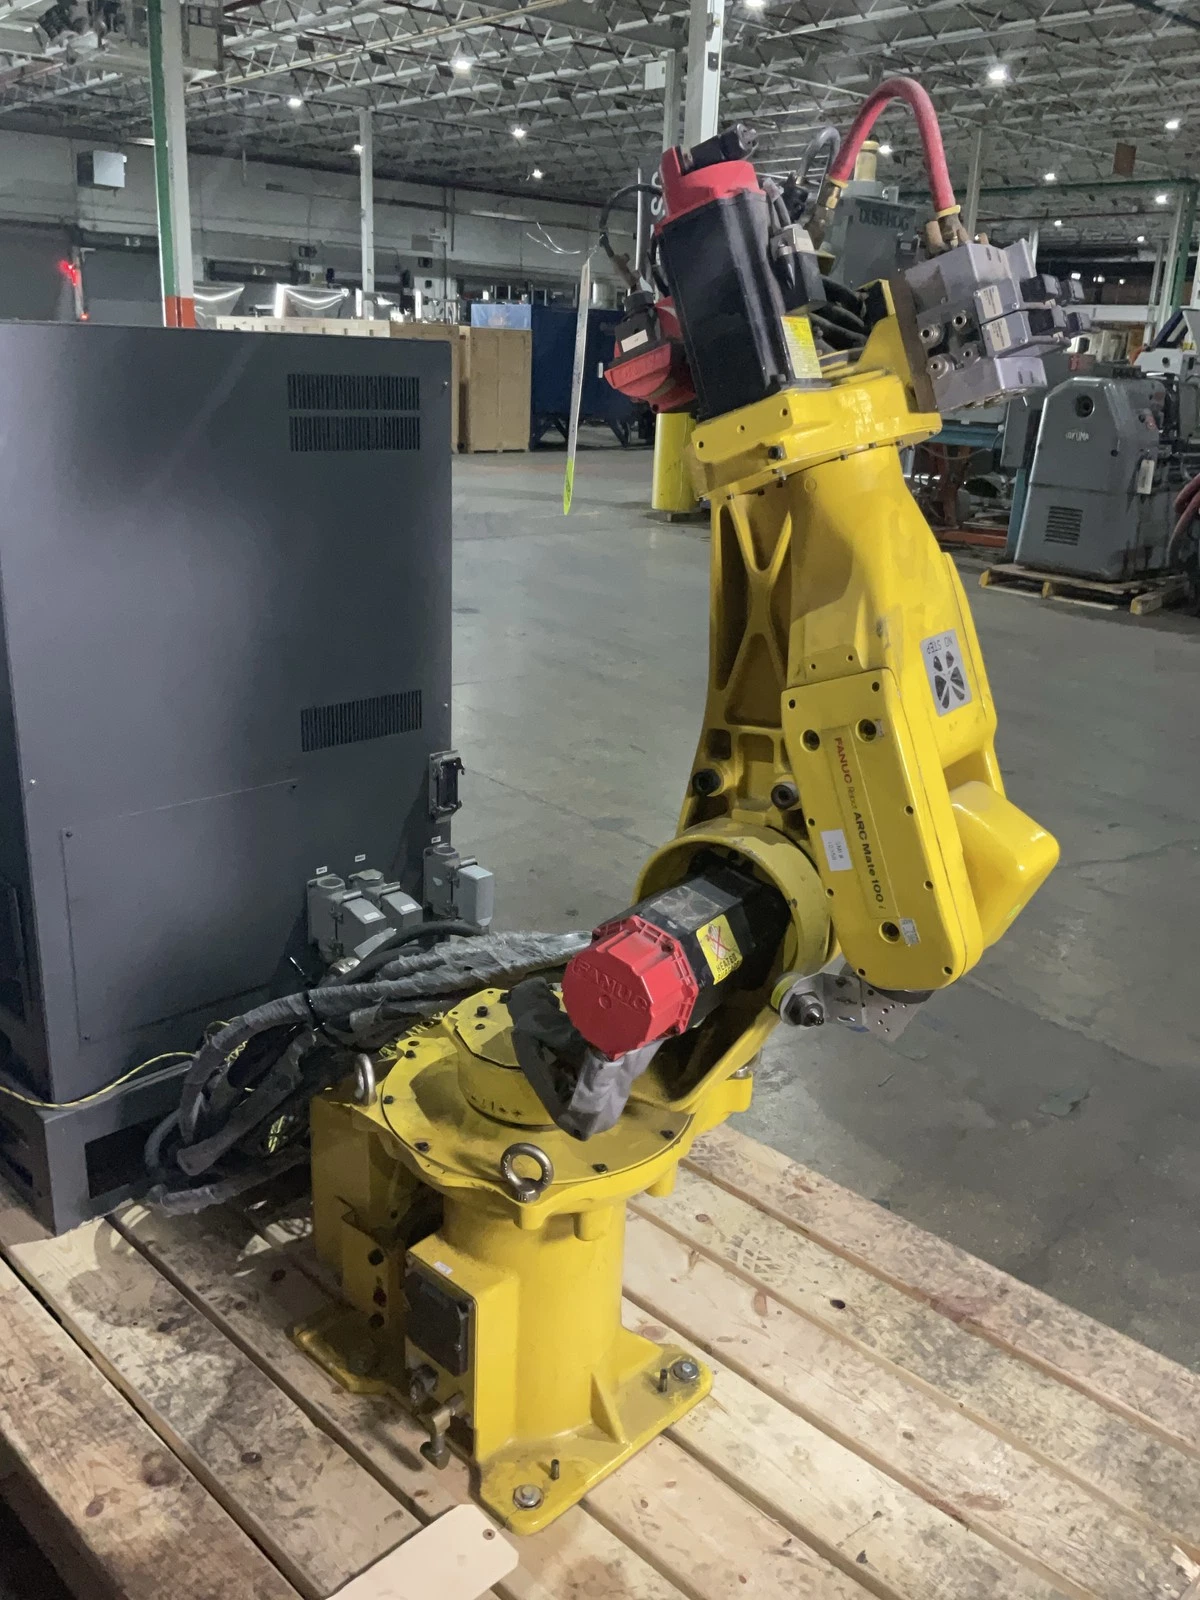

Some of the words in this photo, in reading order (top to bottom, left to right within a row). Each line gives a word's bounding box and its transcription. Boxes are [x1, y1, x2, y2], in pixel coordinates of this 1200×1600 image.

[124, 236, 141, 247] 13
[834, 736, 852, 784] FANUC
[854, 811, 868, 841] ARC
[862, 843, 876, 876] Mate
[716, 952, 738, 972] HEATED
[572, 958, 648, 1011] FANUC
